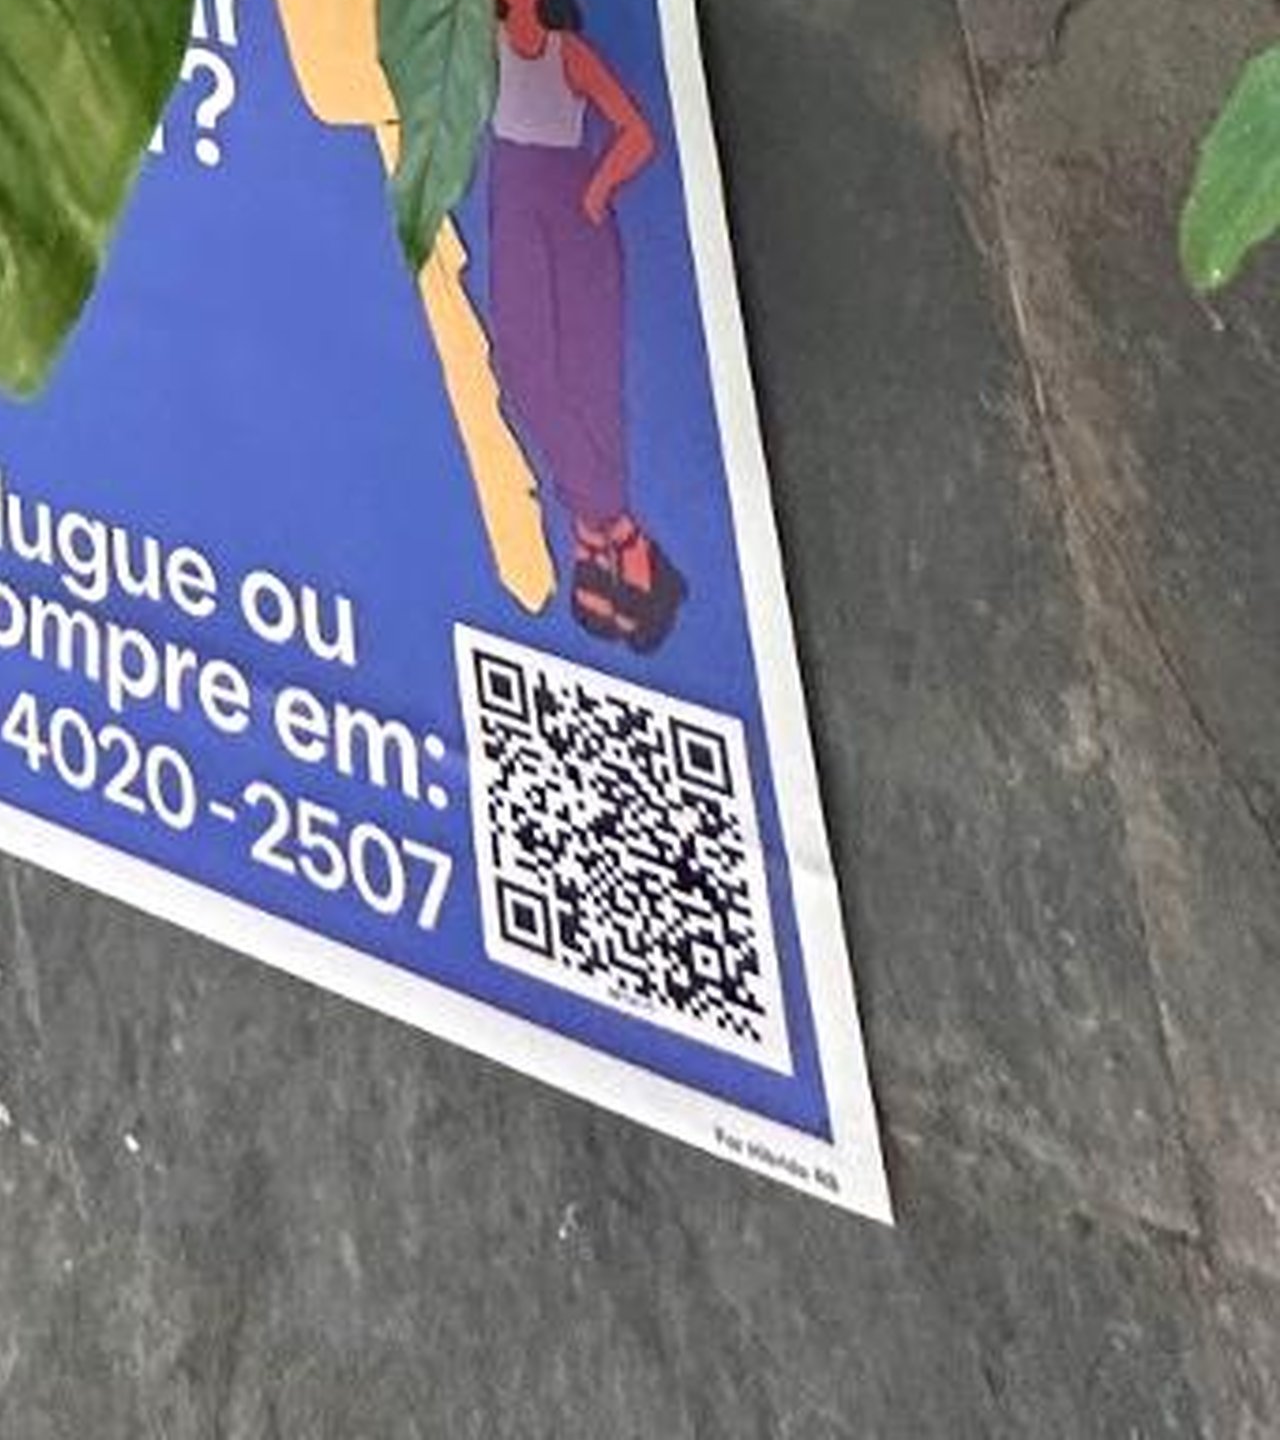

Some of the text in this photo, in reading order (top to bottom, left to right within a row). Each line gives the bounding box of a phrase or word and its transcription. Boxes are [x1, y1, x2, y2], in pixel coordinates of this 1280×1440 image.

[239, 569, 358, 667] ou
[0, 691, 453, 930] 4020-2507
[273, 686, 449, 811] em:
